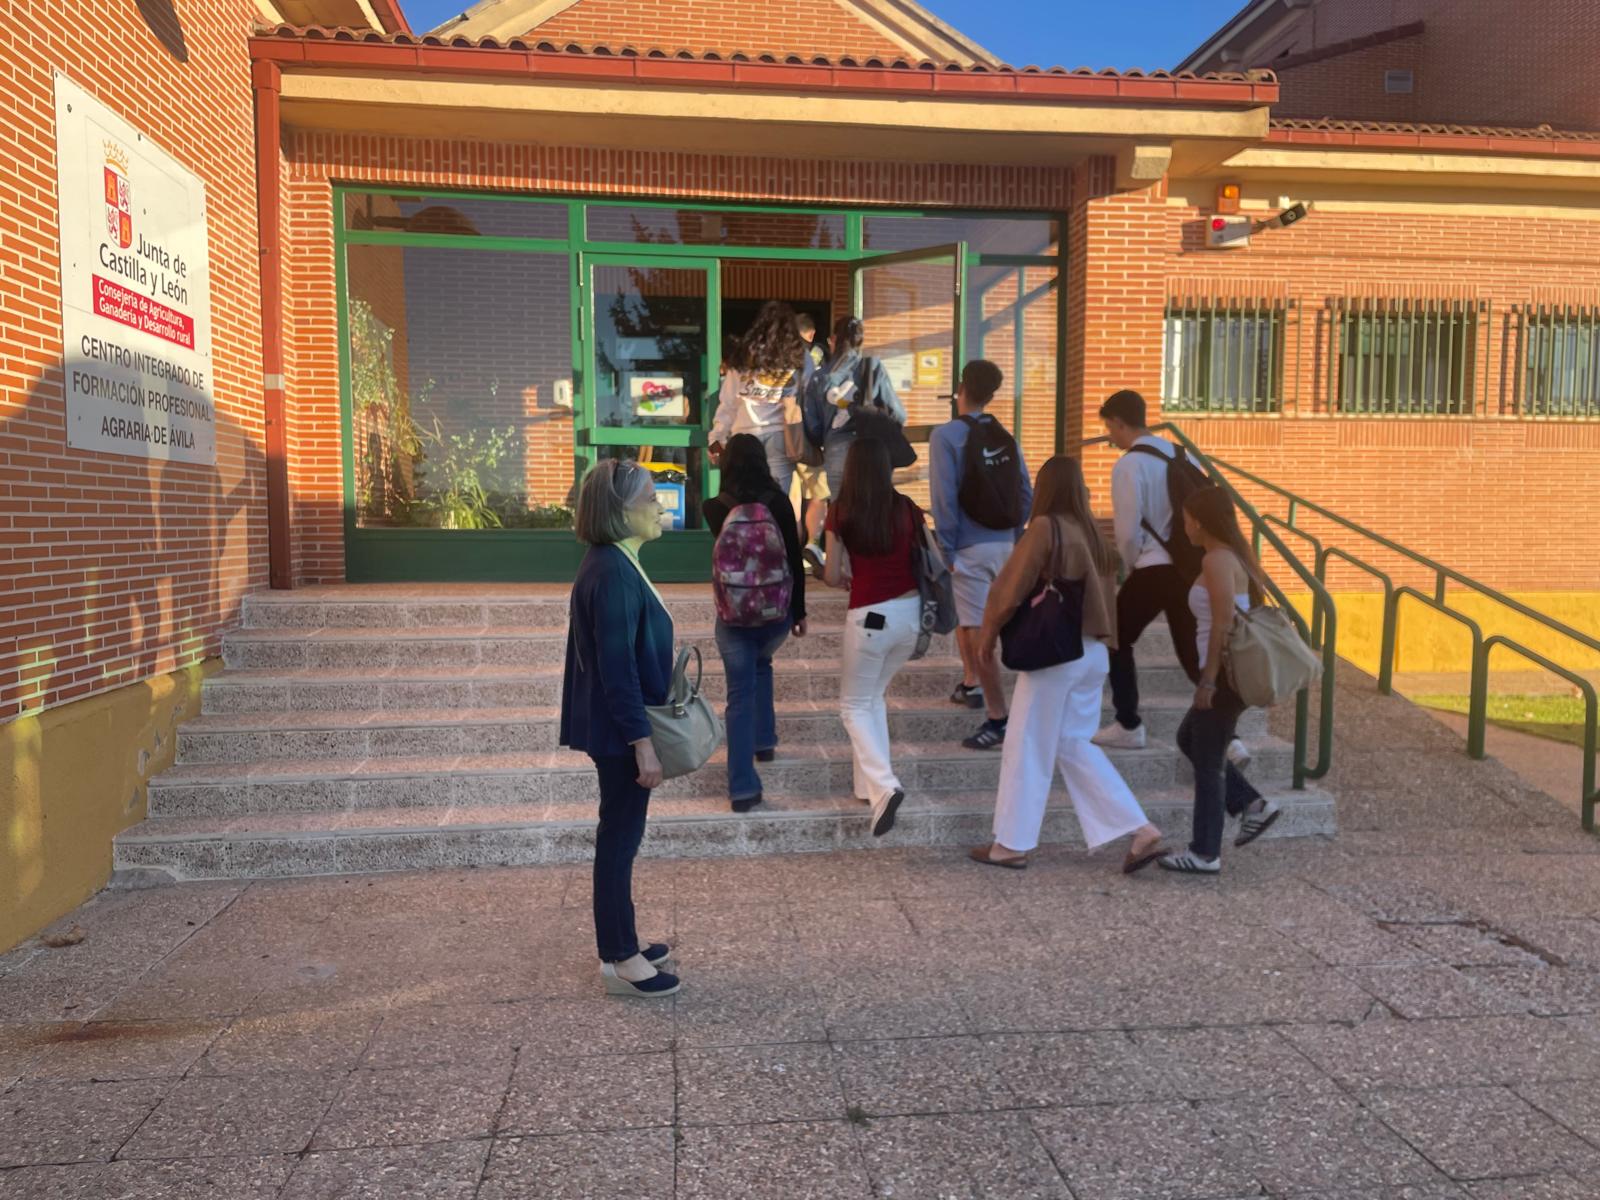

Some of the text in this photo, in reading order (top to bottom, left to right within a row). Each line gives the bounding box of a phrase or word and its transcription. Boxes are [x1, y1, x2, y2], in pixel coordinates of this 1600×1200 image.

[100, 243, 188, 305] Castilla y León
[137, 233, 187, 278] Junta de
[138, 315, 143, 329] y
[144, 315, 176, 340] Desarrollo
[176, 331, 191, 345] rural
[139, 297, 148, 313] de
[149, 301, 185, 330] Agricultura,
[81, 335, 204, 391] CENTRO INTEGRADO DE
[73, 370, 212, 422] FORMACIÓN PROFESIONAL
[101, 416, 195, 449] AGRARIA DE ÁVILA
